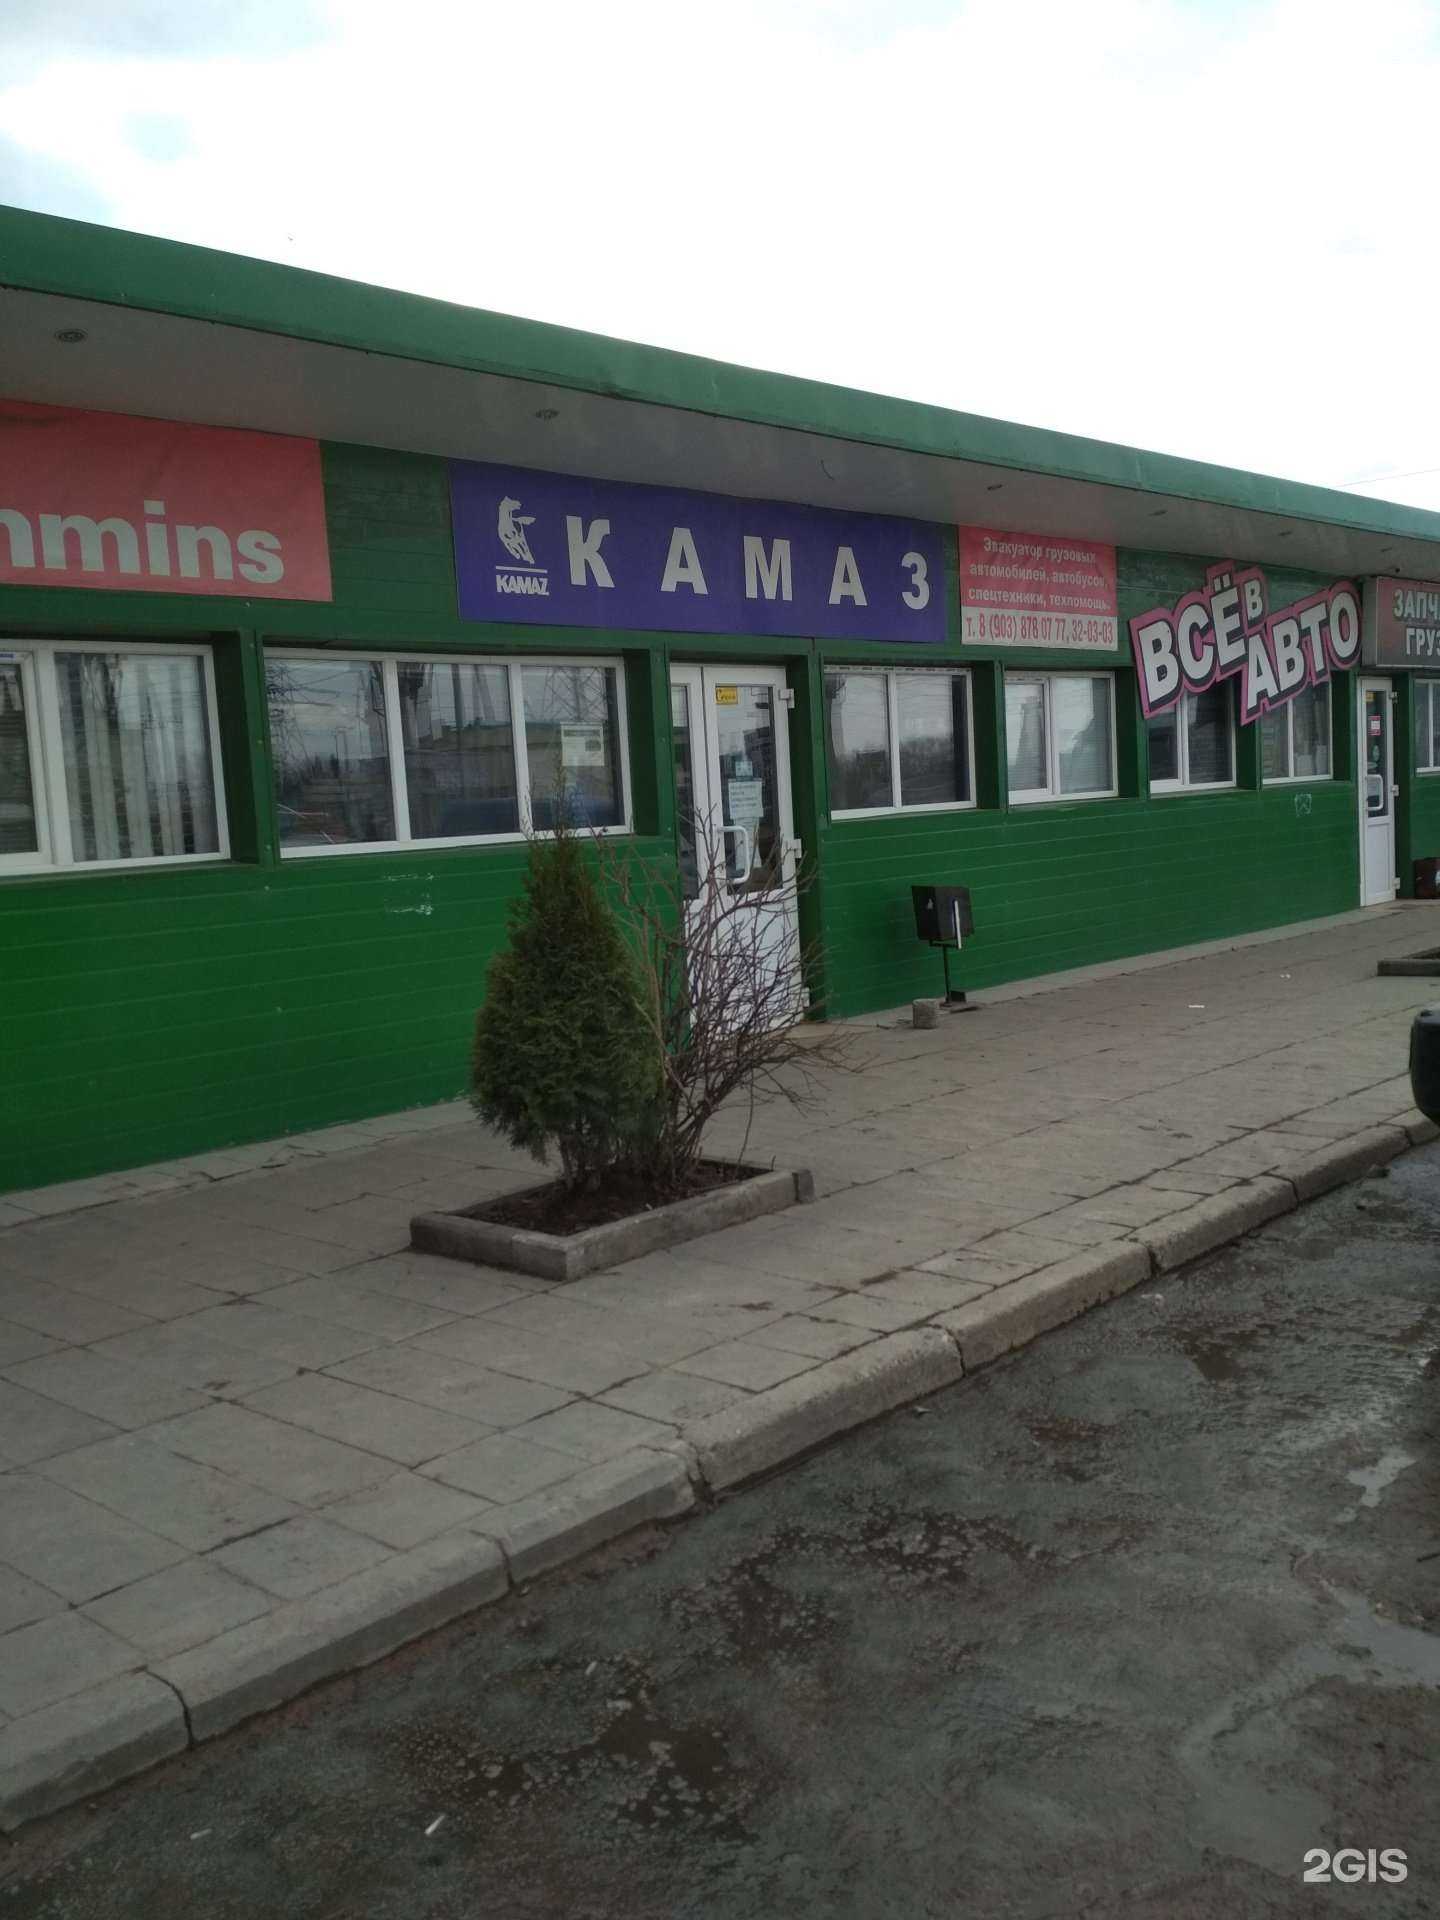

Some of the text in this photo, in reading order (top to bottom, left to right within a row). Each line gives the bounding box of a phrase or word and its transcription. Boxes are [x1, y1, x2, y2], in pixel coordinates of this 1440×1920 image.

[983, 536, 1097, 564] Эвакуатор грузовых
[496, 574, 550, 596] KAMAZ
[969, 562, 1108, 590] автомобилей, автобусов,
[1393, 589, 1440, 621] ЗАПЧ
[978, 613, 986, 638] 8
[989, 614, 1017, 641] (903)
[1021, 615, 1039, 640] 878
[1041, 617, 1052, 641] 07
[1072, 619, 1113, 644] 32-03-03
[1138, 573, 1246, 703] ВСЁ
[1247, 592, 1360, 710] АВТО
